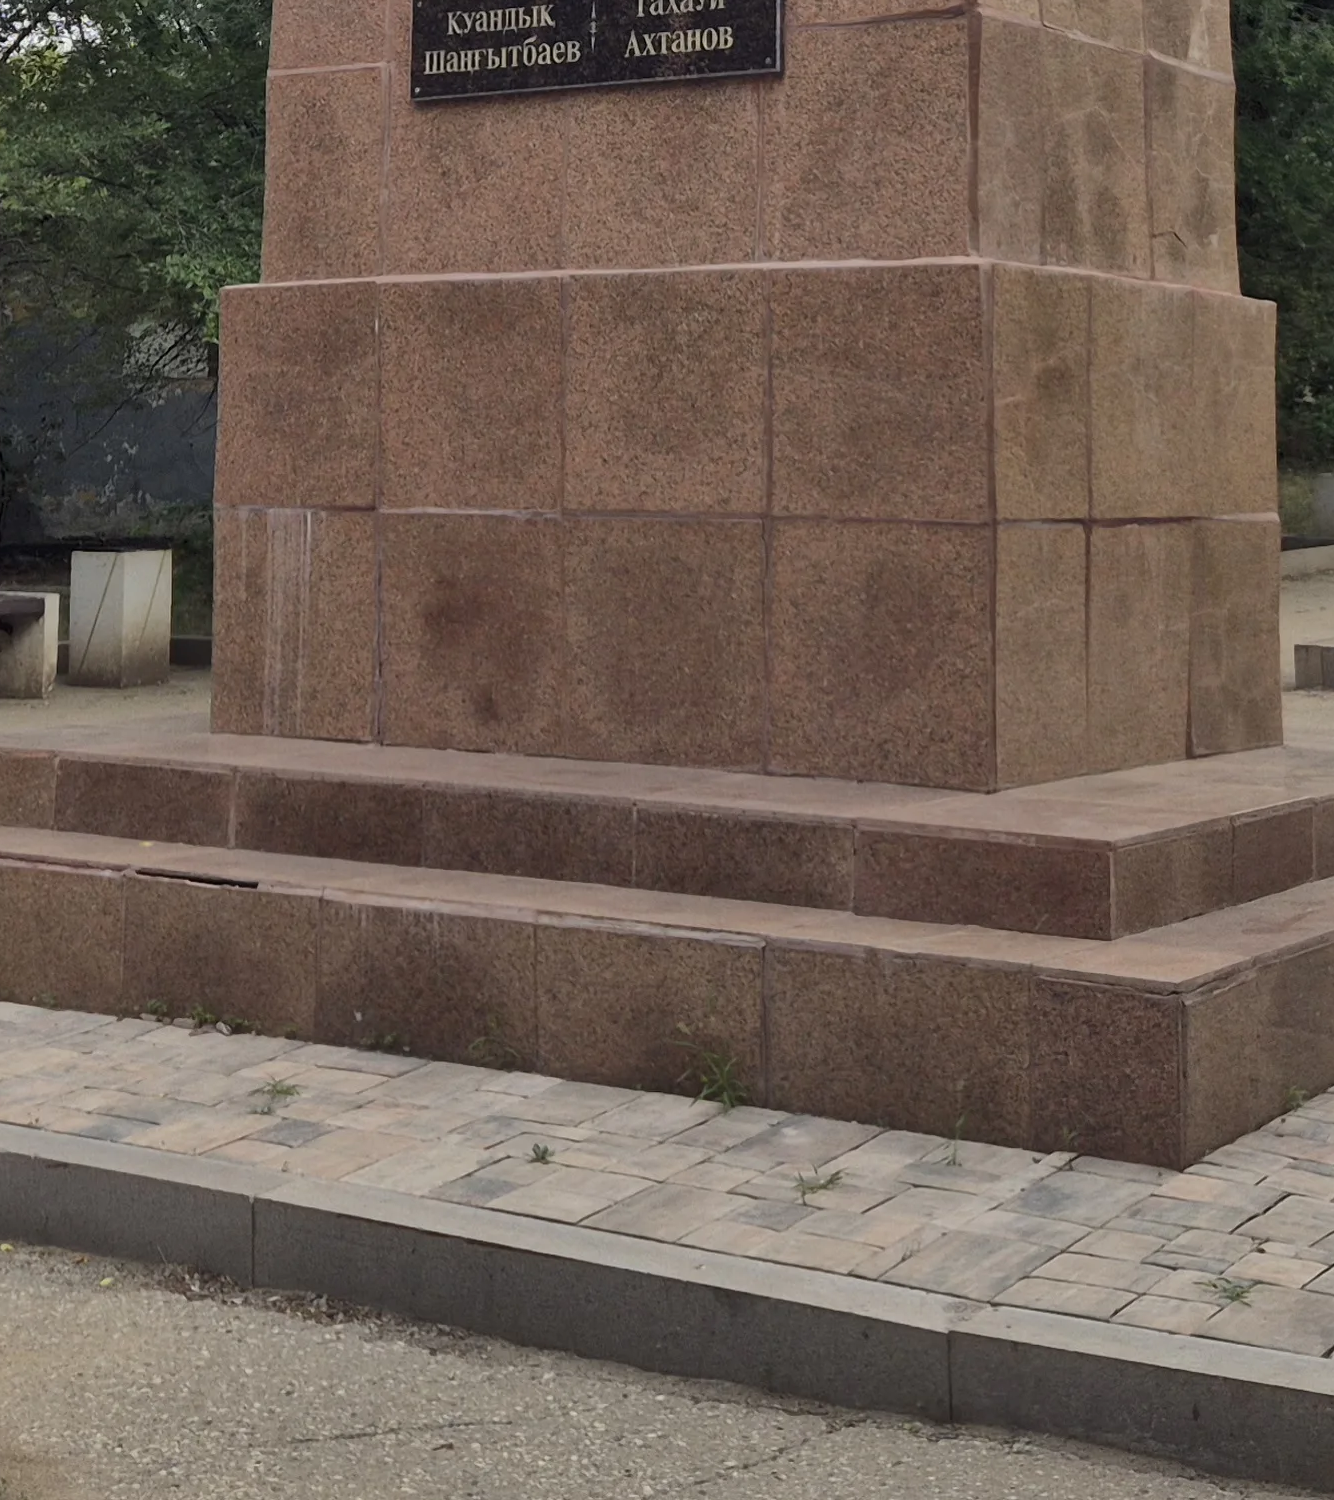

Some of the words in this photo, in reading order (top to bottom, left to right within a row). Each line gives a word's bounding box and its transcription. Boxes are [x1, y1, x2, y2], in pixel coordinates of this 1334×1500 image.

[447, 3, 556, 37] Қуандық
[423, 34, 582, 76] Шаңғытбаев
[624, 25, 734, 59] Ахтанов
